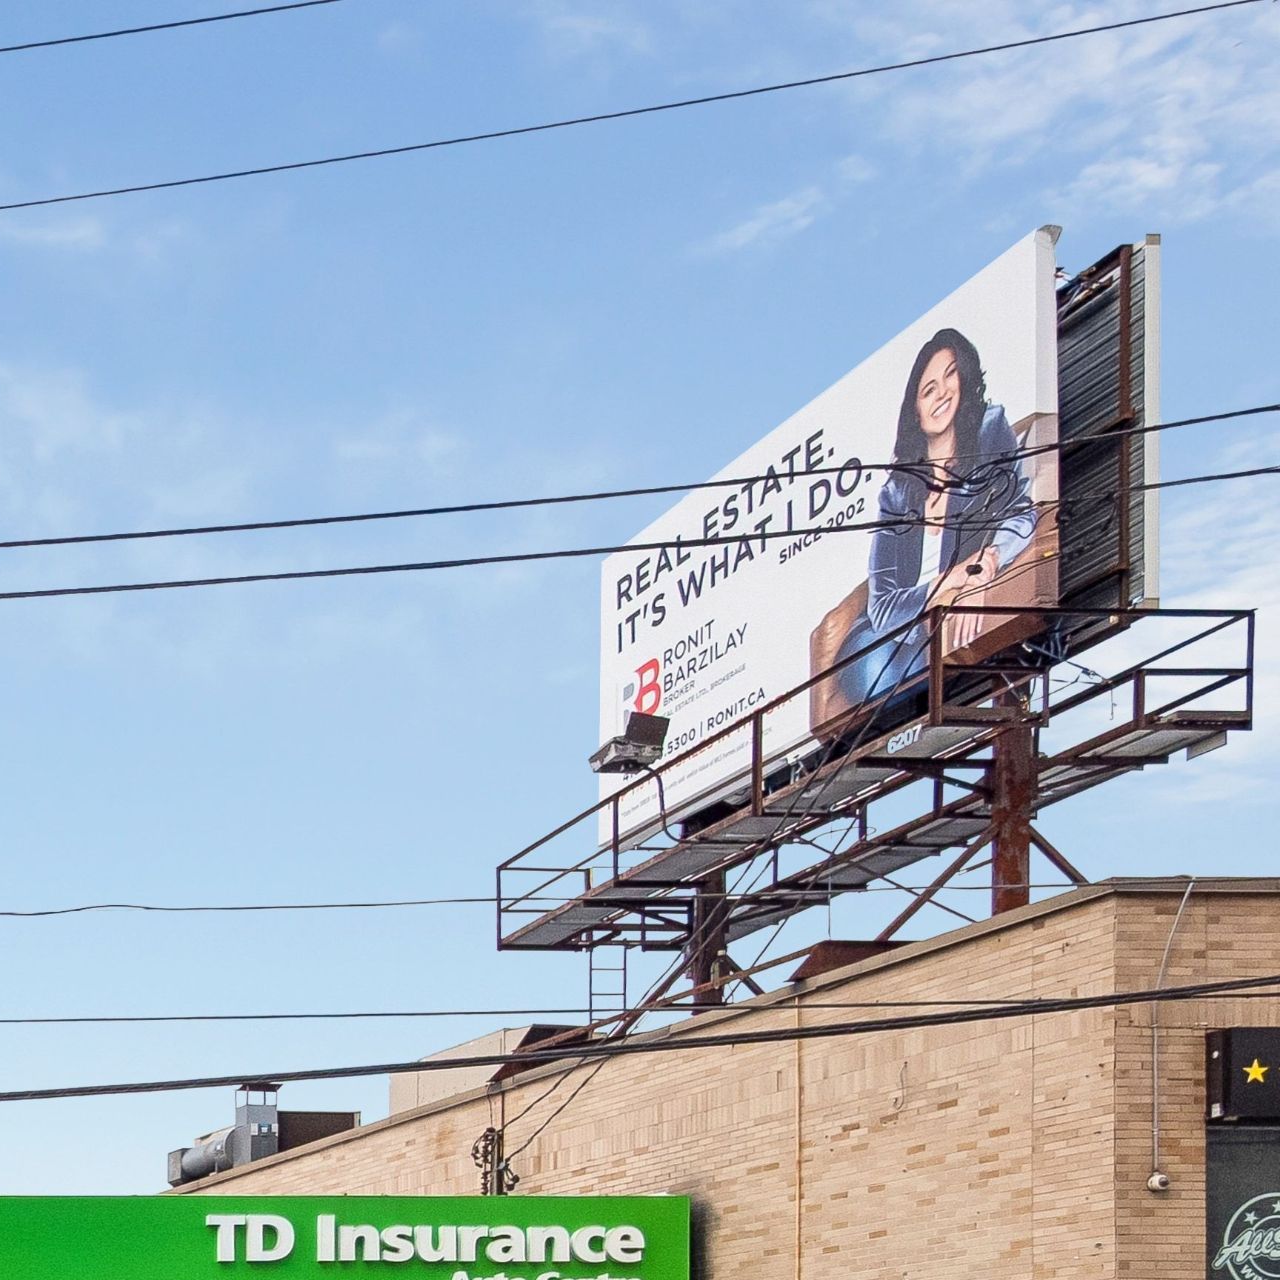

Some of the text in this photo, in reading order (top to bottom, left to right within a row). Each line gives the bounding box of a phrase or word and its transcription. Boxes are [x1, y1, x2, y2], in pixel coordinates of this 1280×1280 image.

[617, 428, 835, 611] REAL ESTATE.
[778, 497, 865, 565] SINCE 2002
[617, 456, 872, 654] IT'S WHAT I DO.
[663, 618, 715, 669] RONIT
[663, 622, 748, 693] BARZILAY
[663, 679, 696, 707] BROKER
[707, 686, 766, 732] RONIT.CA
[887, 723, 922, 754] 6207
[205, 1213, 645, 1264] TD Insurance
